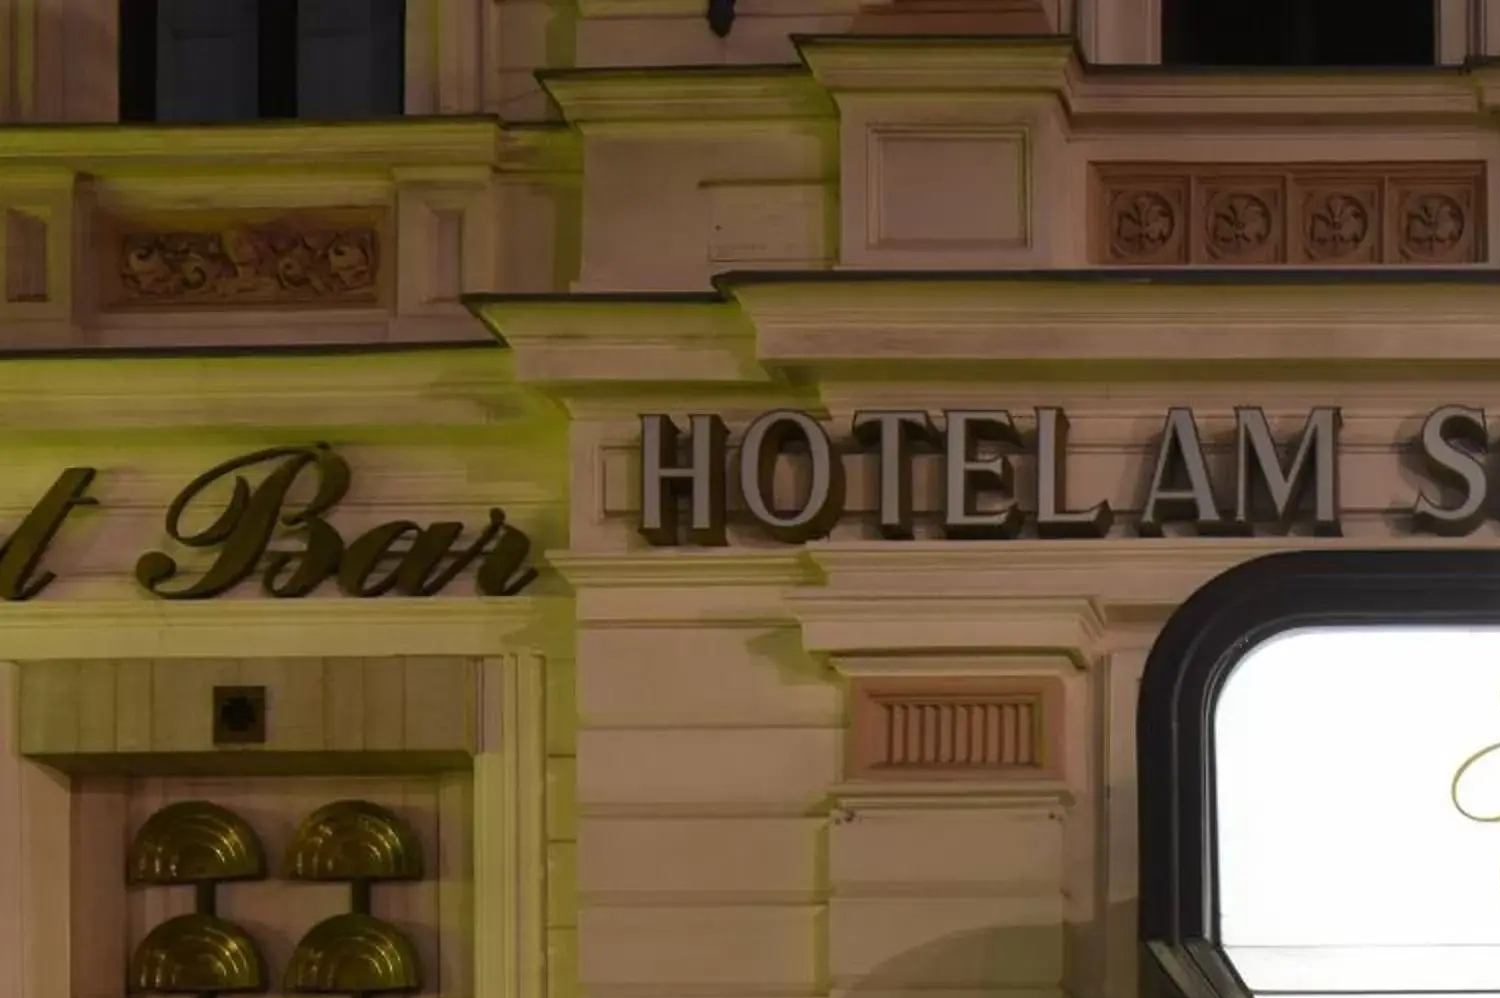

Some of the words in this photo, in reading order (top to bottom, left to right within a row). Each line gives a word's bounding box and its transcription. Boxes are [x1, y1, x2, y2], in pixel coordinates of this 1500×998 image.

[135, 441, 538, 599] Bar
[638, 405, 1112, 544] HOTEL
[1140, 405, 1342, 538] AM
